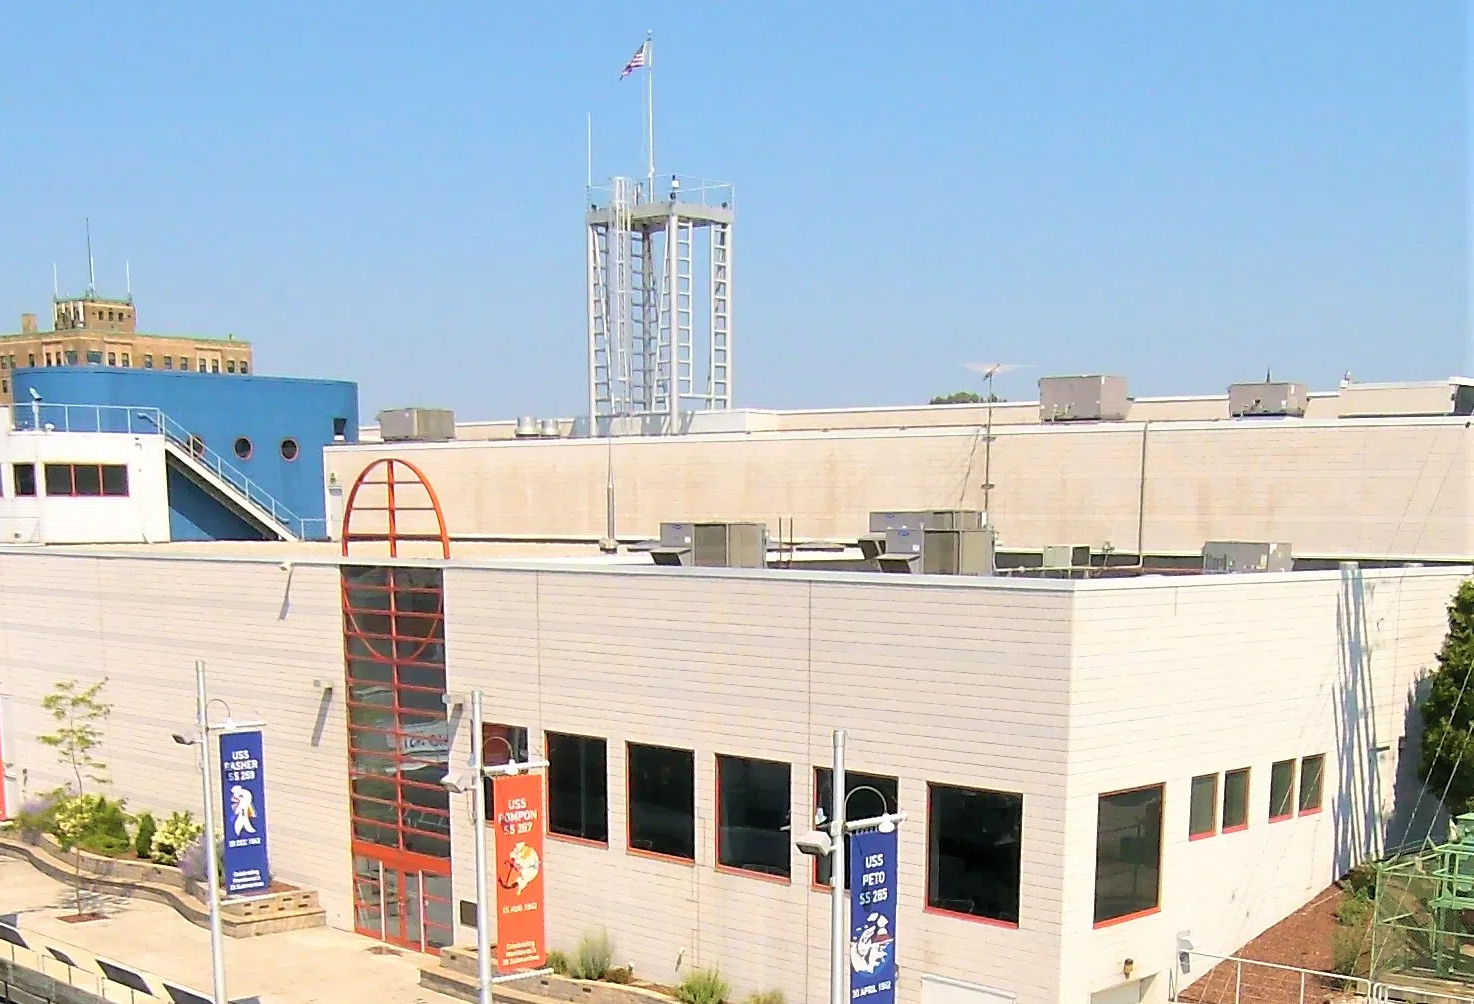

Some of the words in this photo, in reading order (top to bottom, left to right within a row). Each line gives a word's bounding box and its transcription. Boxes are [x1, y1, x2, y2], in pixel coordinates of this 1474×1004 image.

[231, 749, 250, 760] USS
[508, 797, 527, 810] USS
[497, 809, 538, 825] POMPON
[865, 853, 884, 869] USS
[862, 871, 886, 887] PETO
[859, 891, 871, 905] SS
[872, 887, 888, 903] 265
